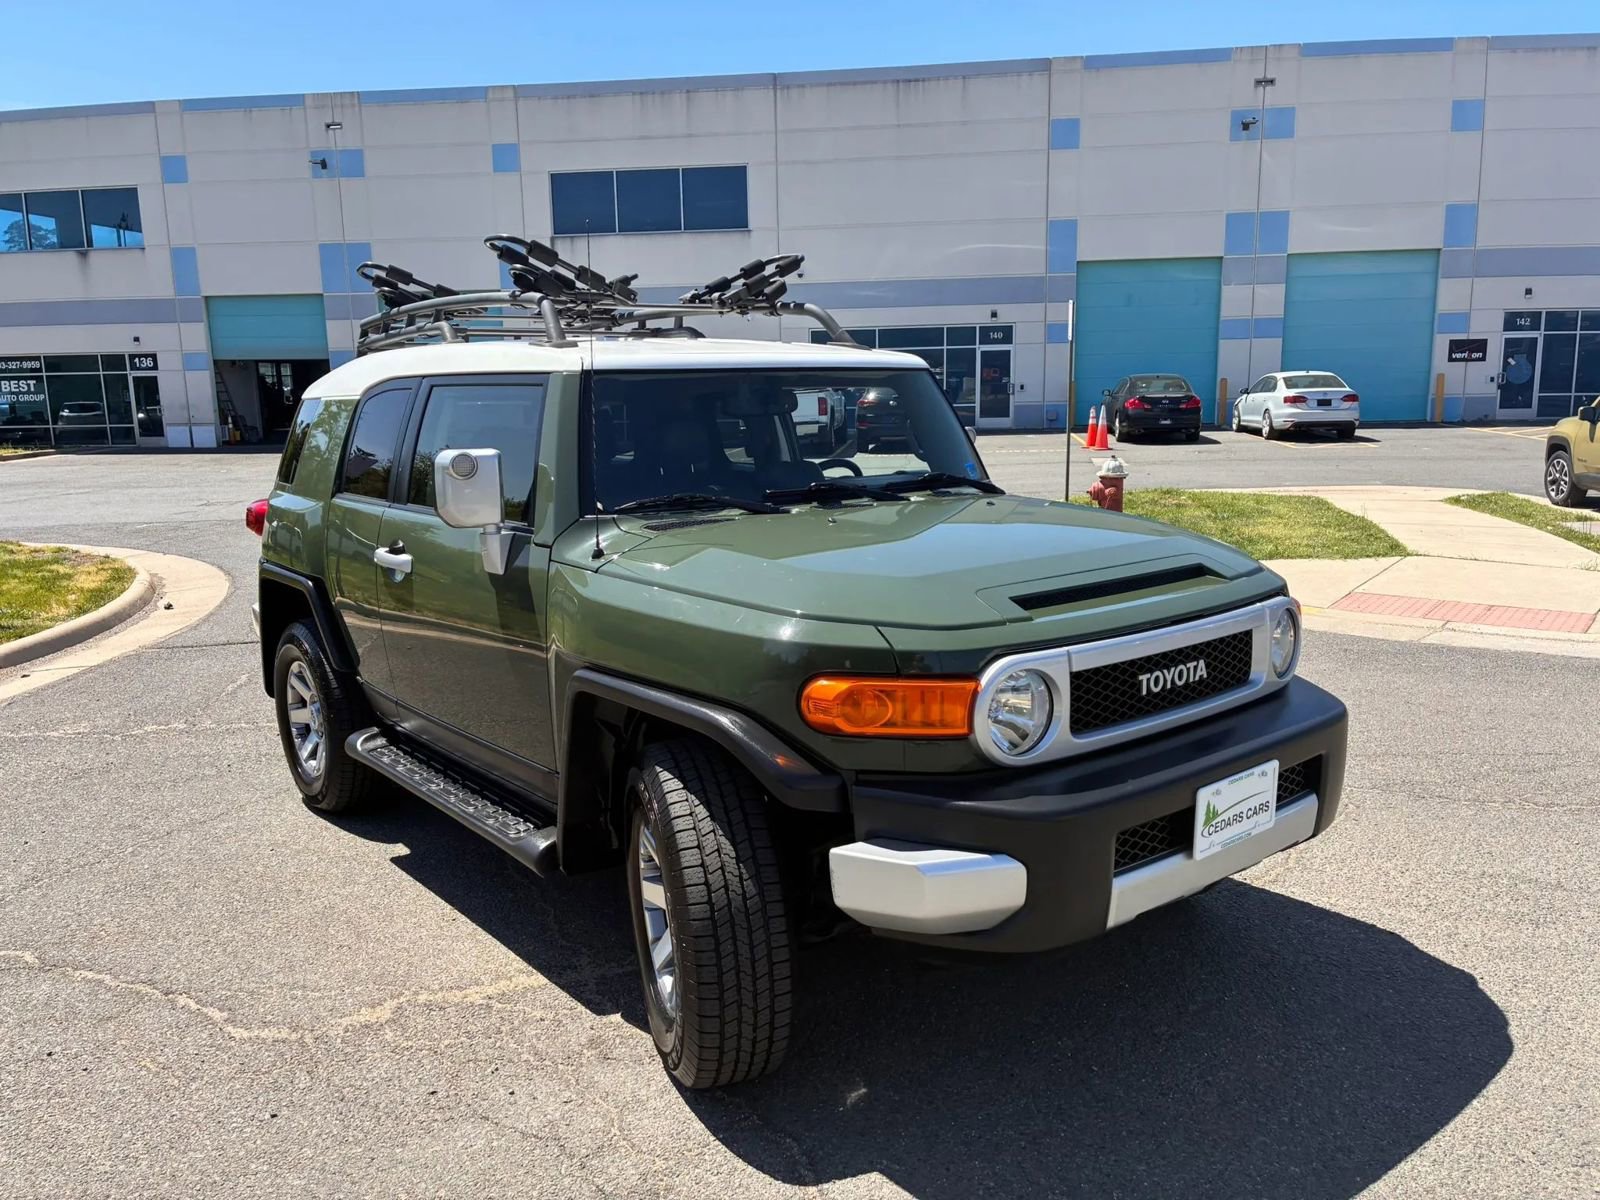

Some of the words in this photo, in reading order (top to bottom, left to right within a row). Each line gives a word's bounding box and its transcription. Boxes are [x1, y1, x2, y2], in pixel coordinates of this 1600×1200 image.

[1516, 317, 1531, 326] 142
[989, 331, 1003, 340] 140
[133, 357, 154, 368] 136
[1, 380, 37, 392] BEST
[18, 394, 45, 402] GROUP
[1138, 659, 1208, 696] TOYOTA
[1207, 811, 1244, 836] CEDARS
[1245, 800, 1270, 820] CARS
